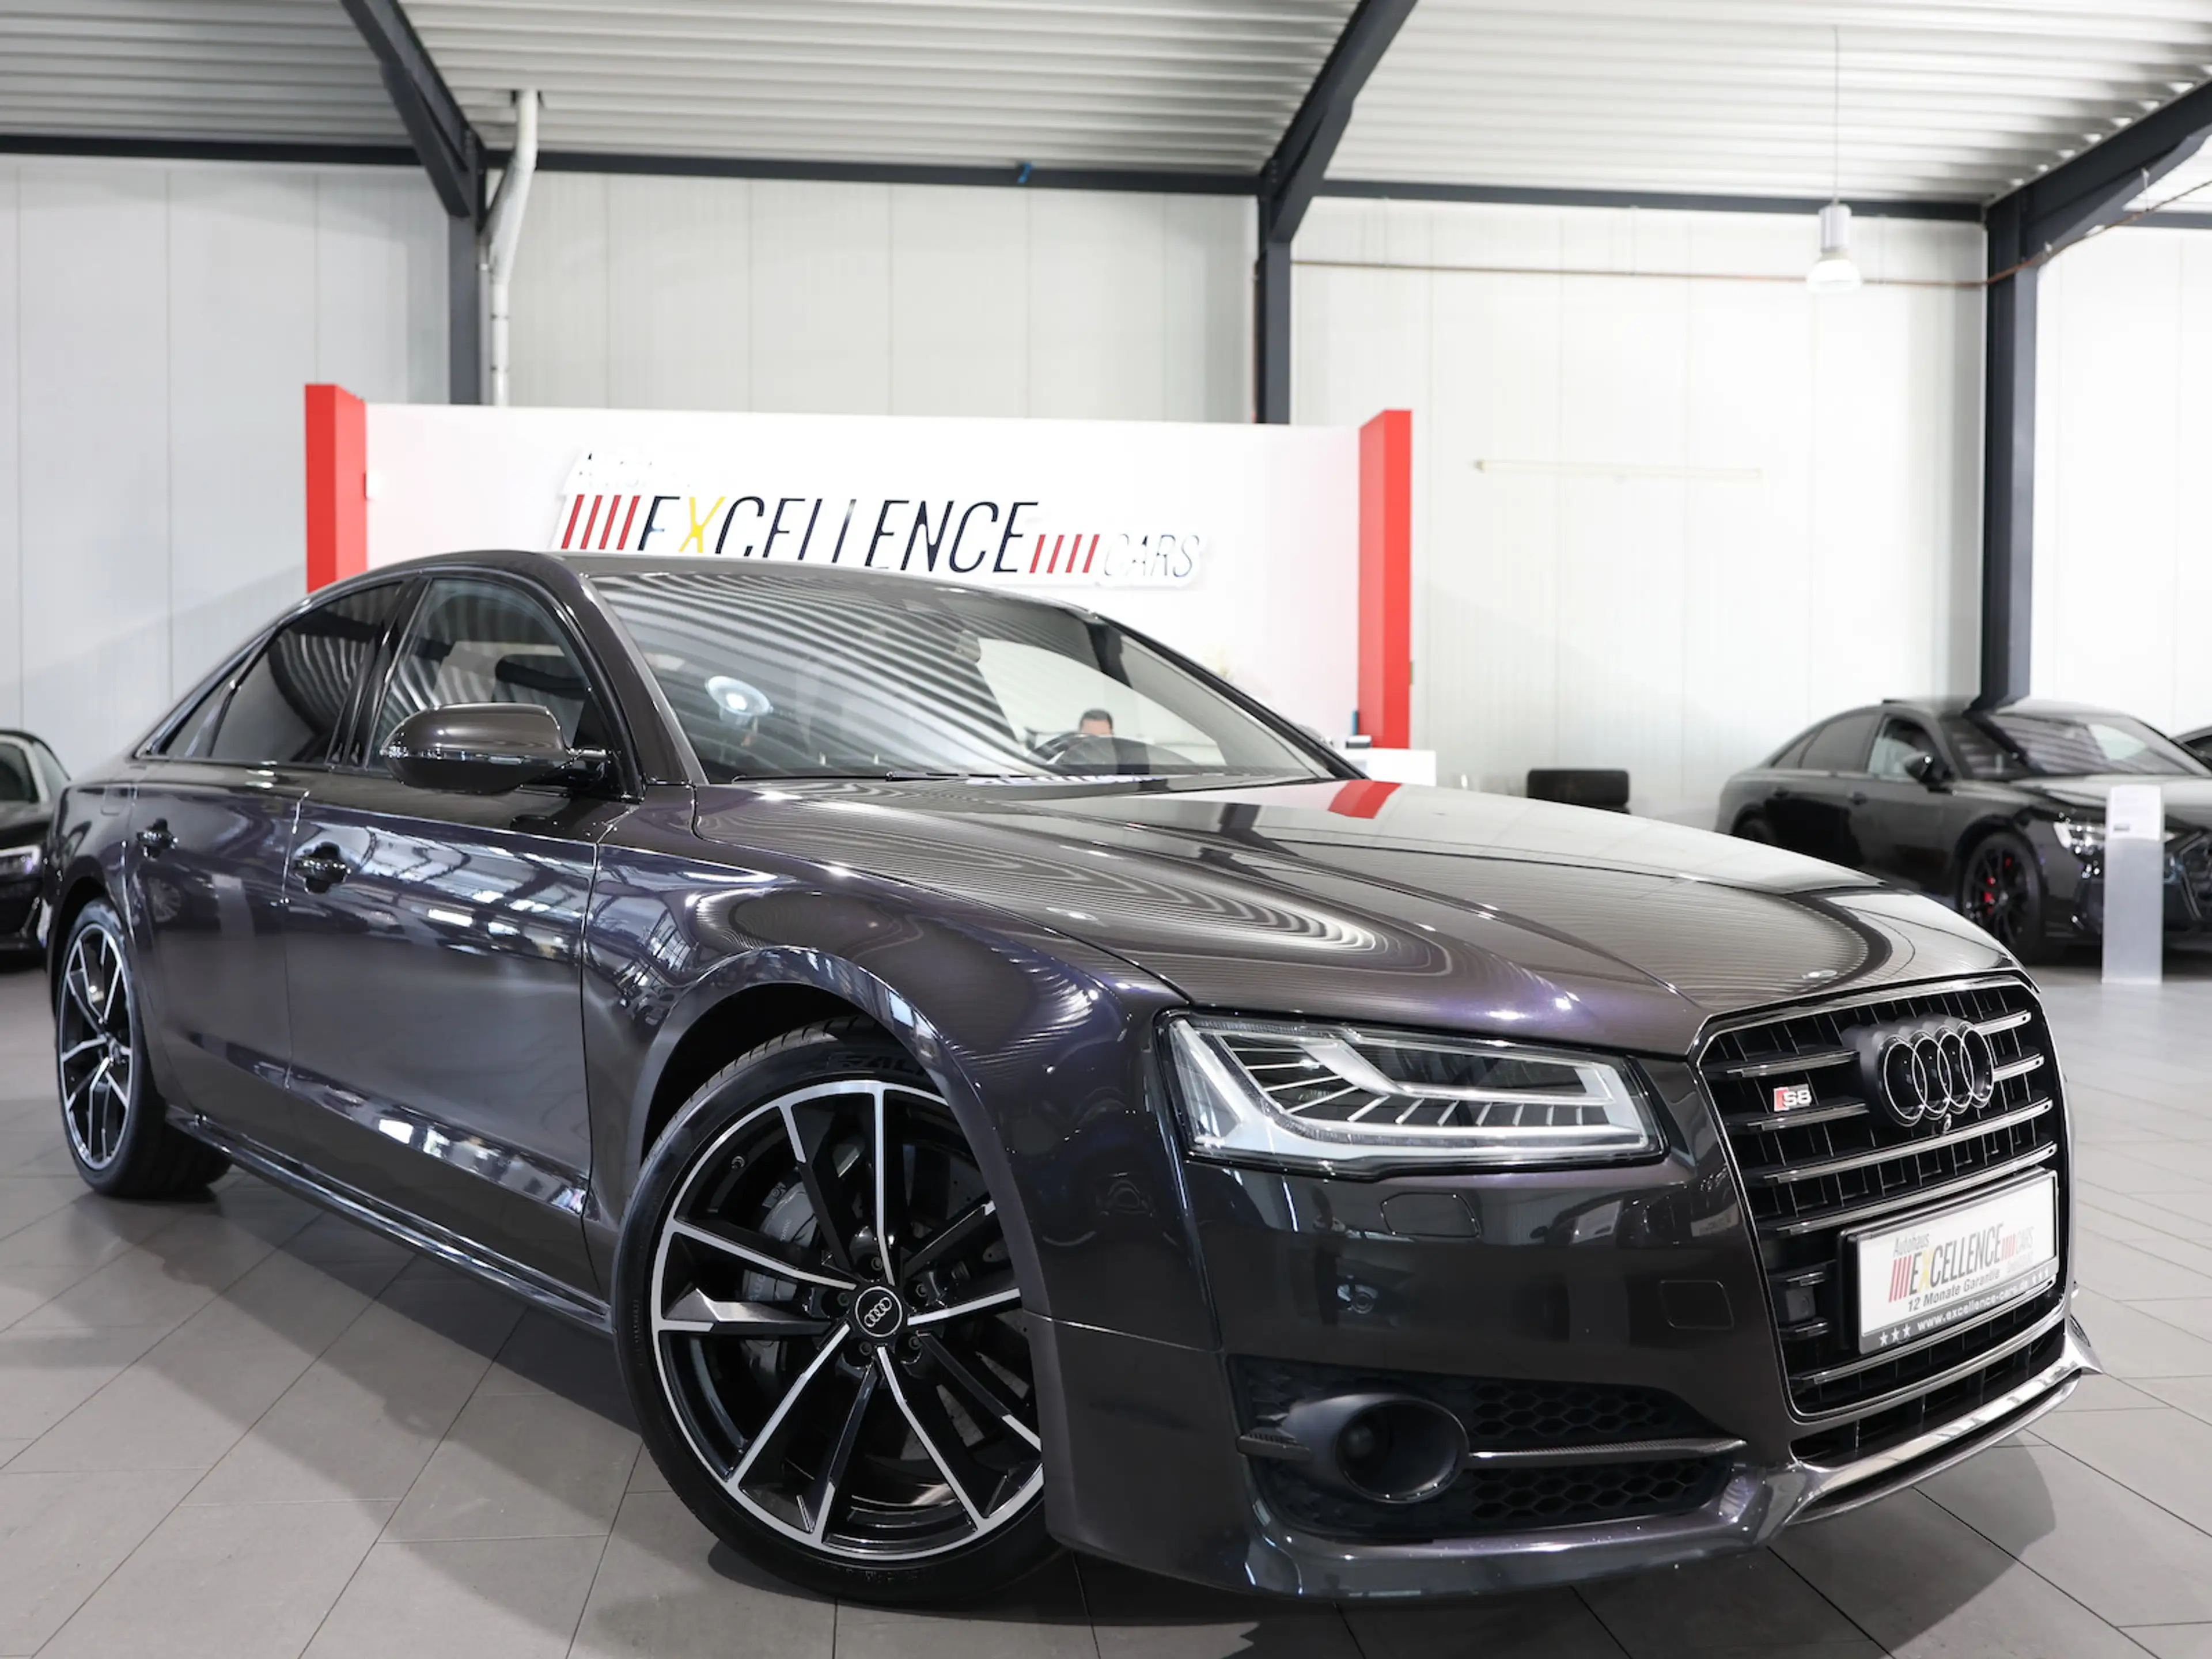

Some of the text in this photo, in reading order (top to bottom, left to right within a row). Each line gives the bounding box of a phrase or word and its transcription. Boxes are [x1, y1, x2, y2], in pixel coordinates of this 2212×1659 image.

[1103, 533, 1200, 578] CARS
[1783, 1089, 1812, 1106] S8
[1908, 1222, 2004, 1296] EXCELLENCE
[1908, 1298, 1921, 1313] 12
[1923, 1283, 1961, 1309] Monate
